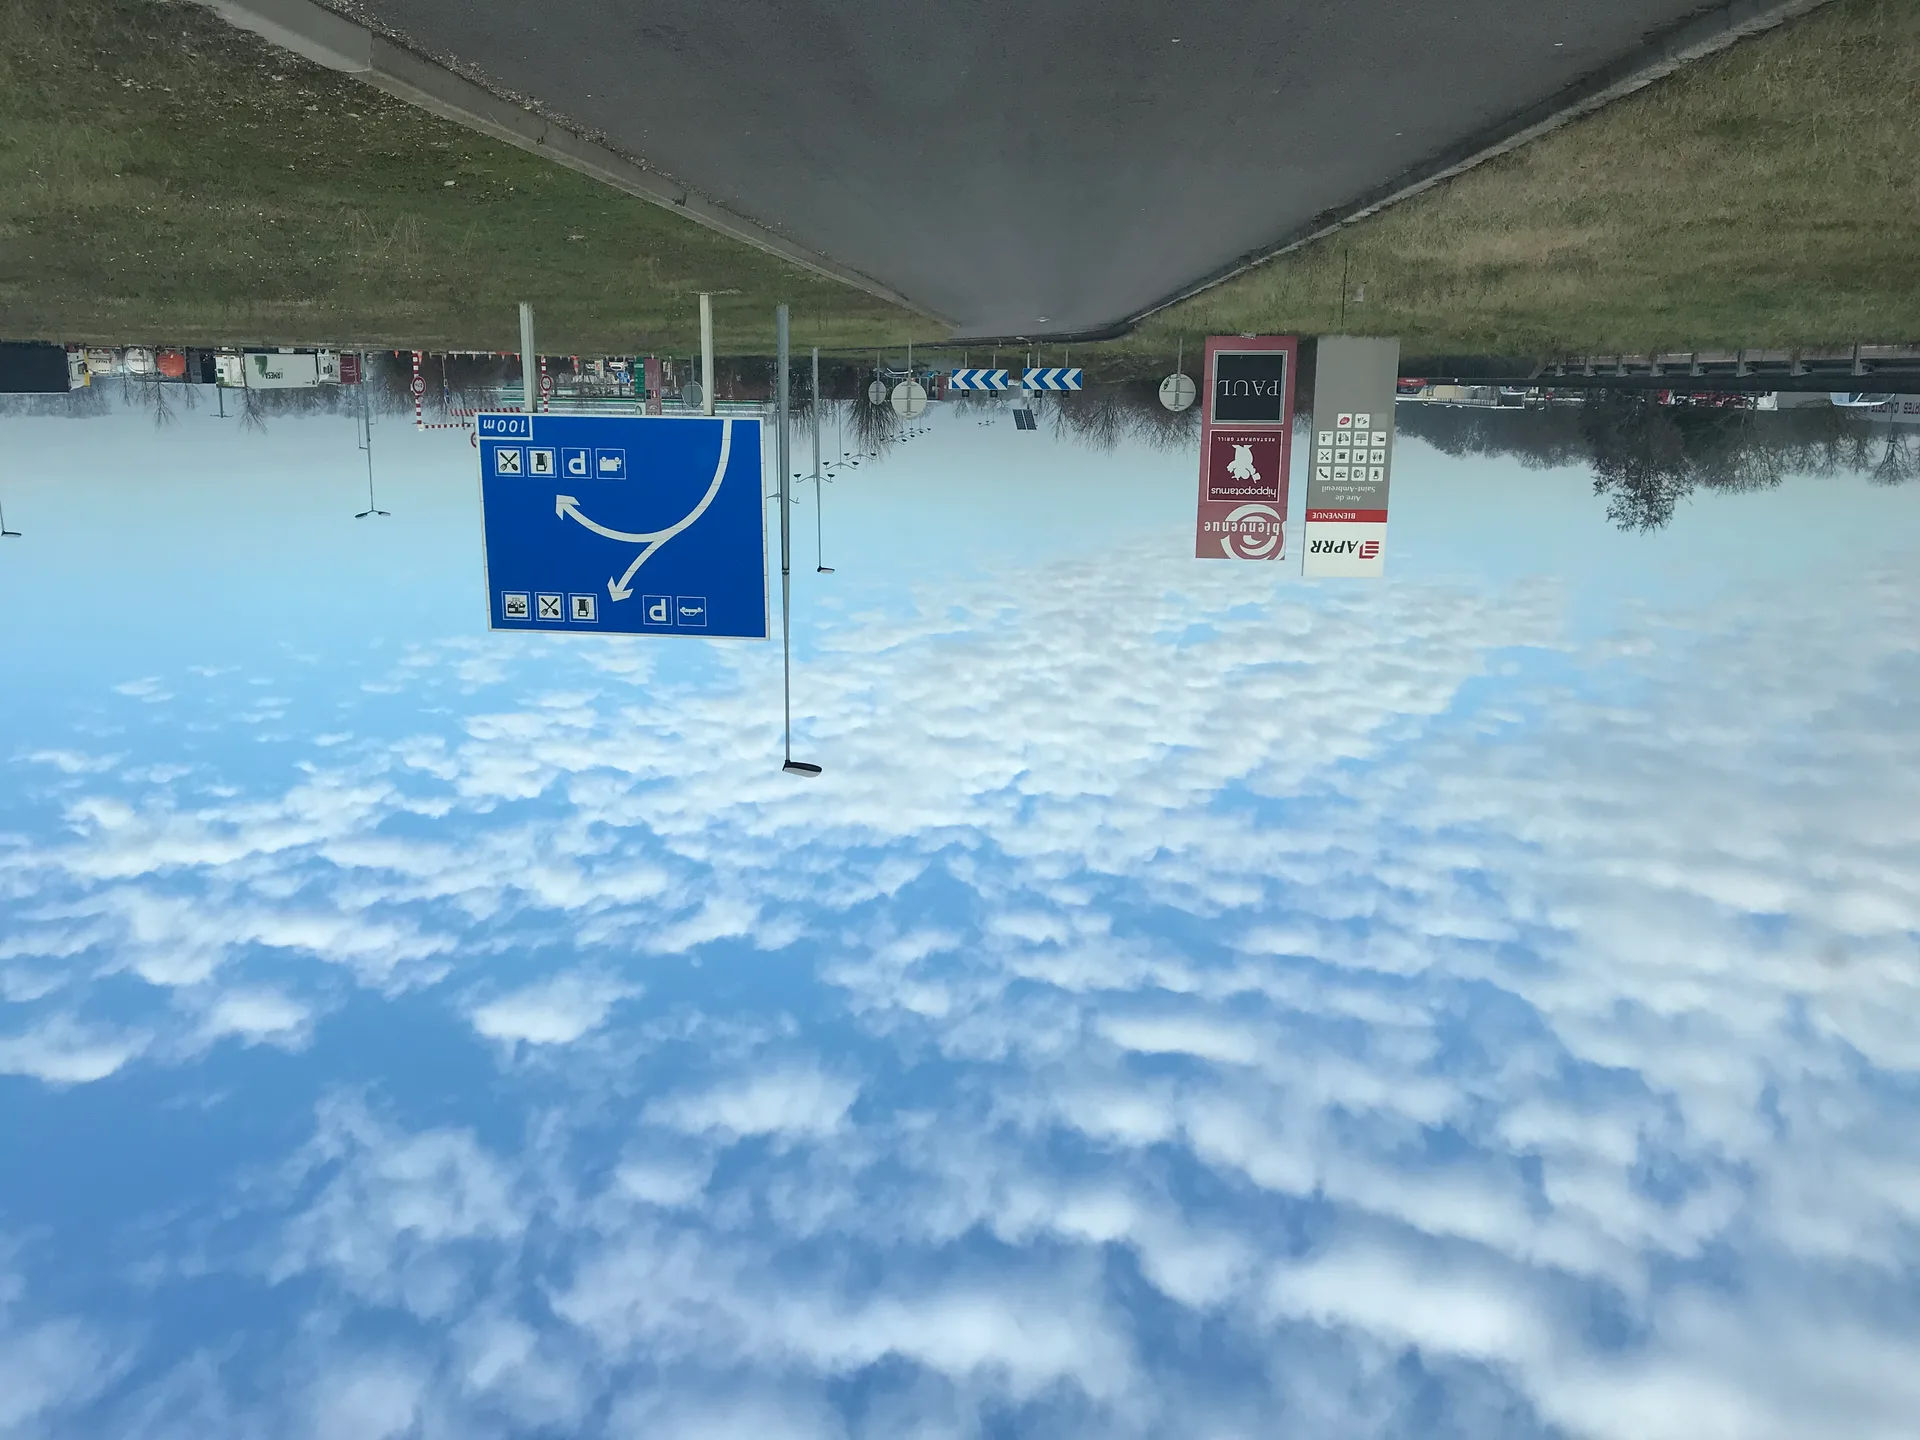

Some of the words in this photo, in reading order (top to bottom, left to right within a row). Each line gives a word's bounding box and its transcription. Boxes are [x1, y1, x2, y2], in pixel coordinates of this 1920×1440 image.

[1218, 379, 1279, 396] PAUL
[1904, 402, 1920, 414] RTES
[569, 451, 585, 474] P
[1211, 487, 1276, 497] hippopotamus
[1204, 521, 1280, 536] bienvenue
[1310, 540, 1359, 554] APRR
[649, 598, 666, 621] P
